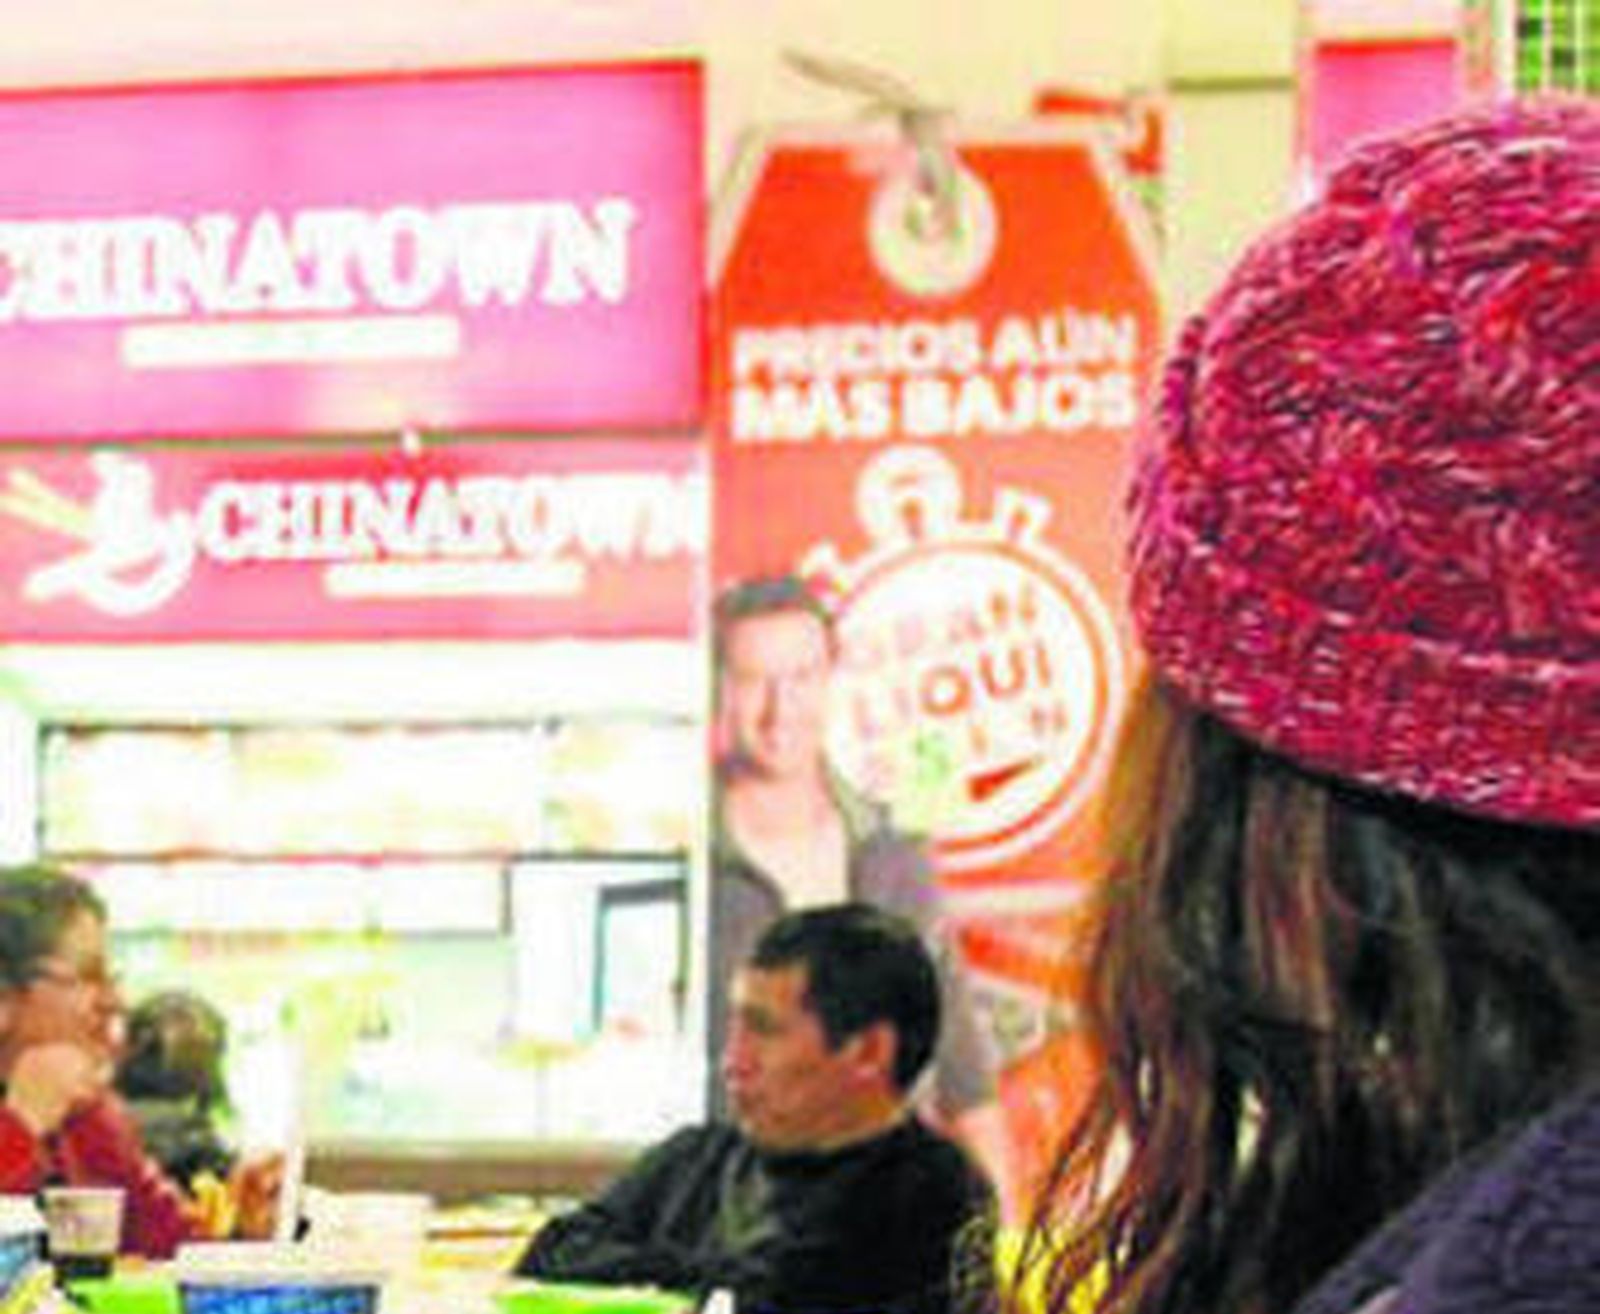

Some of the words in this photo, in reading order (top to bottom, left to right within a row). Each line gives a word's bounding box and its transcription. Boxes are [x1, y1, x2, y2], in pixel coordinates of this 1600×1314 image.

[732, 318, 983, 381] PRECIOS
[901, 369, 1138, 436] BAJOS
[201, 472, 703, 563] CHINATOWN
